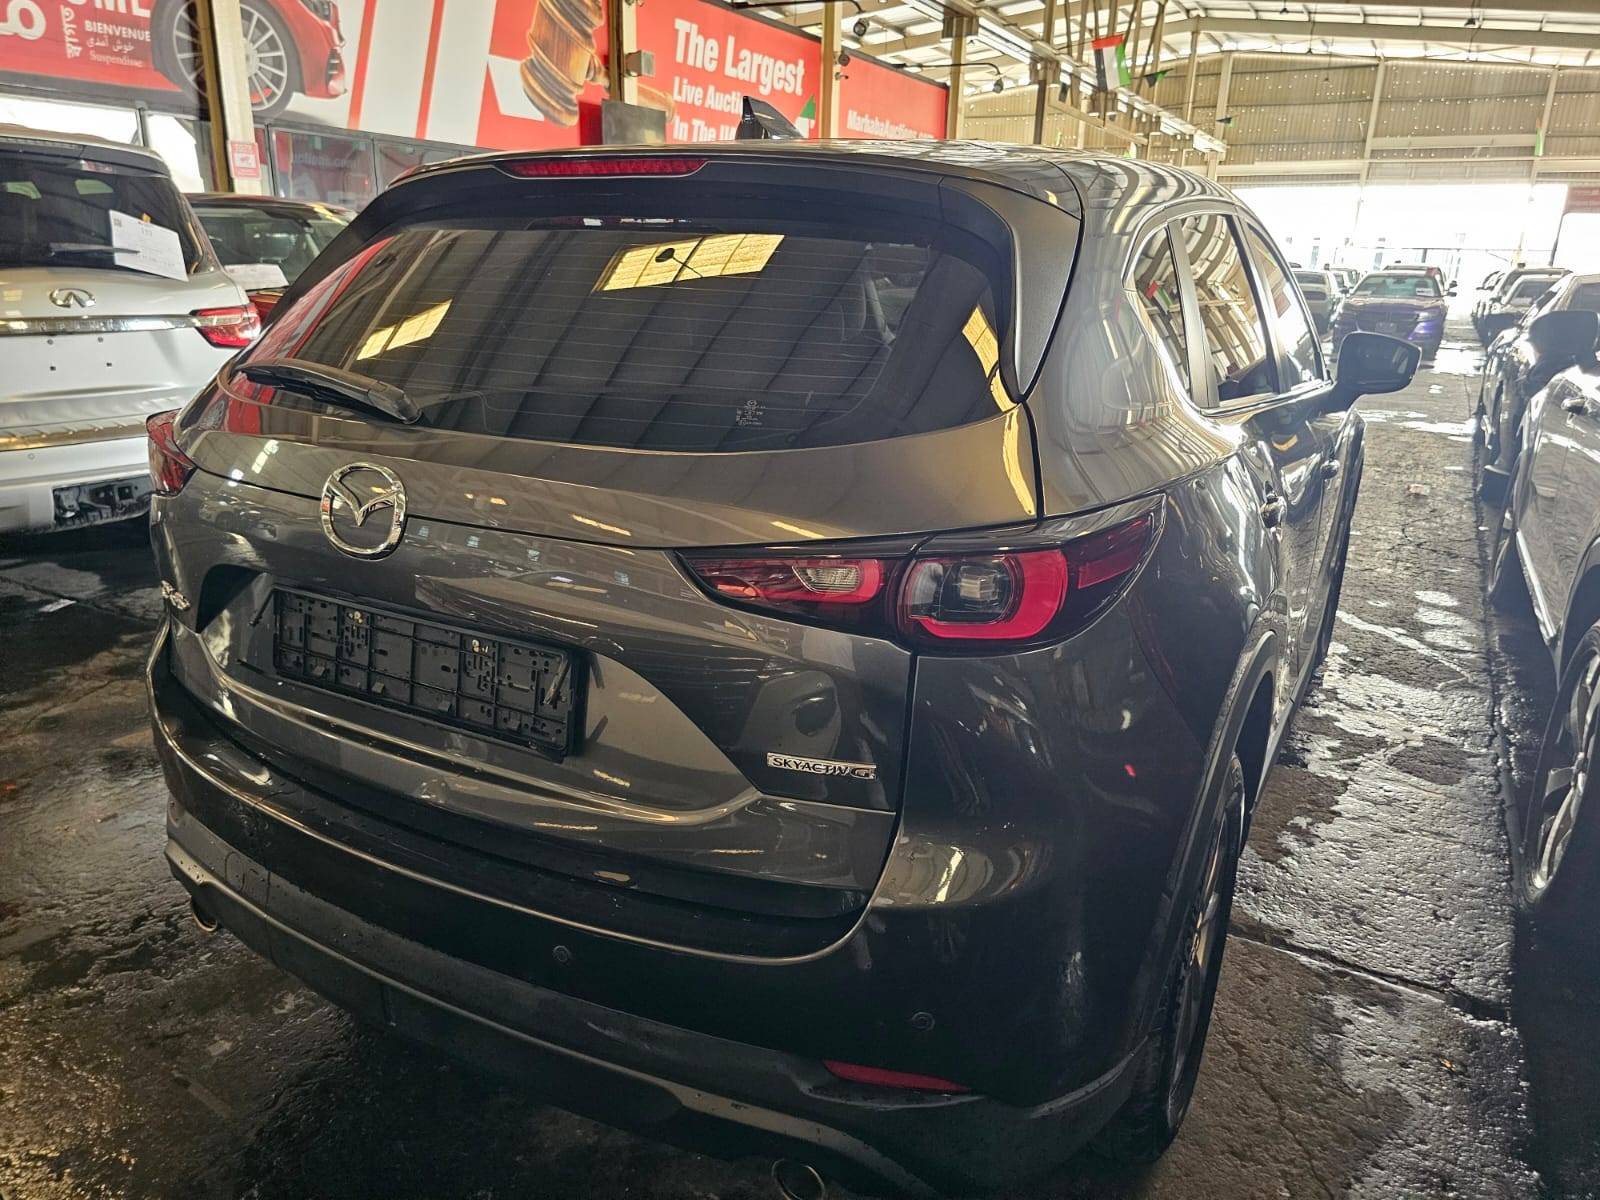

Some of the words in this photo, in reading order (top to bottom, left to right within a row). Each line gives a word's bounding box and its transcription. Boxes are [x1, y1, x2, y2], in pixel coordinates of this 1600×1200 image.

[84, 20, 151, 42] BIENVENUE
[674, 17, 719, 72] The
[724, 34, 805, 96] Largest
[673, 76, 703, 107] Live
[704, 84, 743, 115] Aucti
[673, 115, 689, 141] In
[692, 118, 717, 141] The
[772, 757, 849, 775] SKYACTIV
